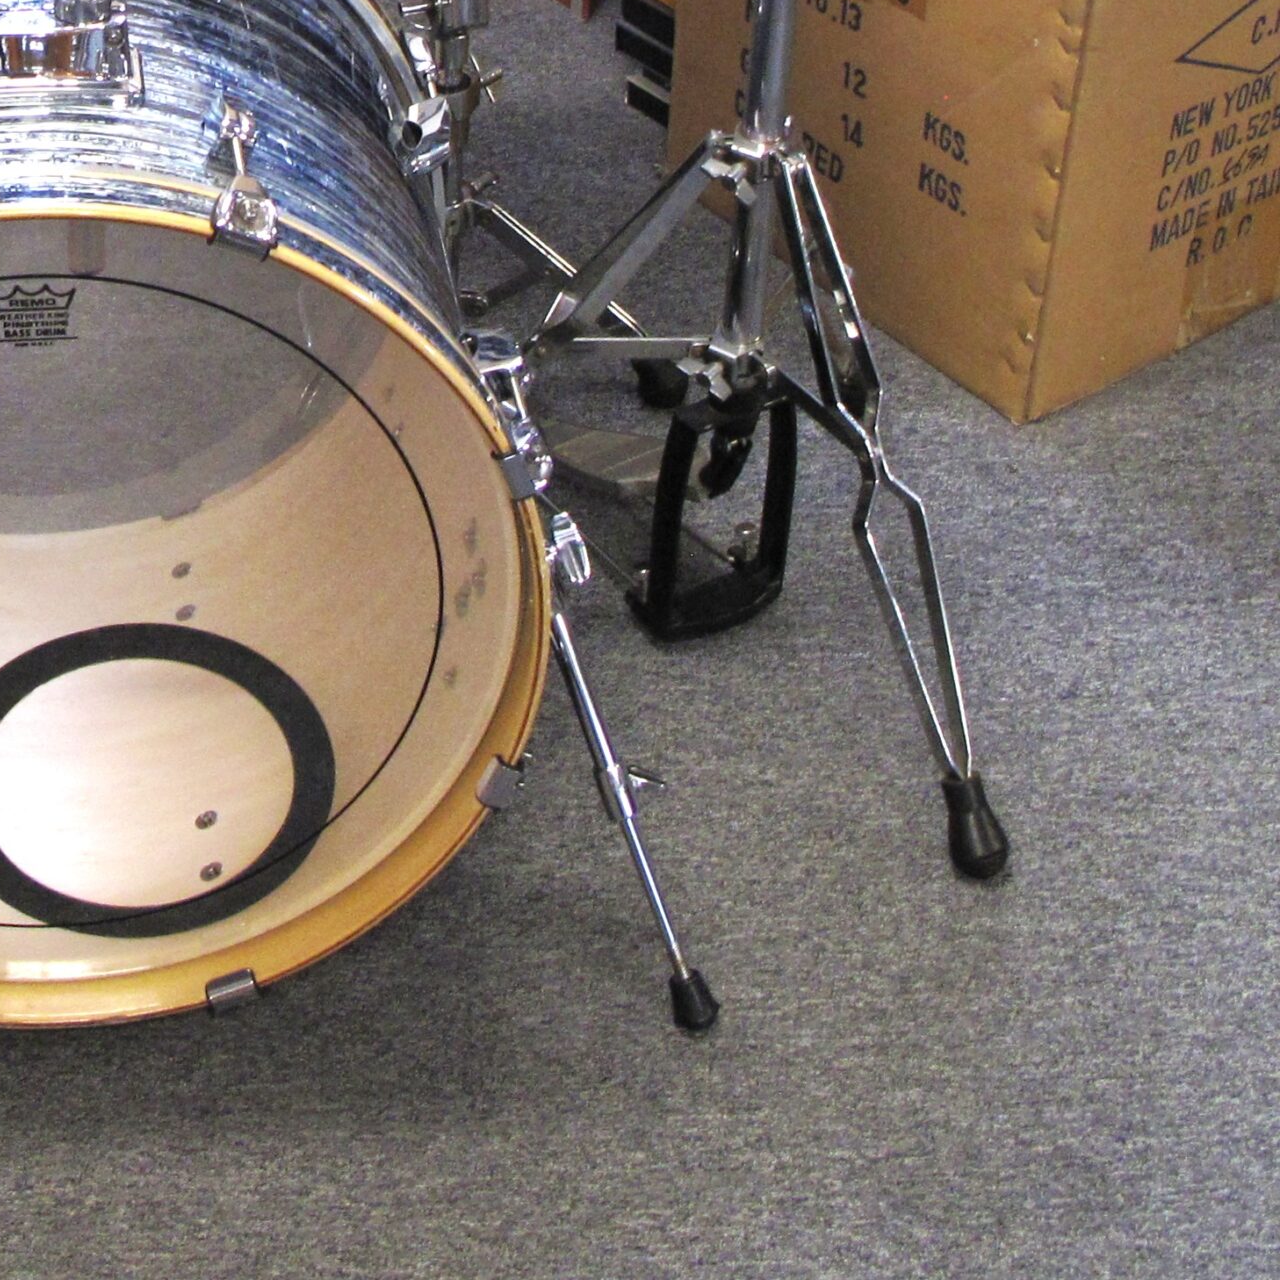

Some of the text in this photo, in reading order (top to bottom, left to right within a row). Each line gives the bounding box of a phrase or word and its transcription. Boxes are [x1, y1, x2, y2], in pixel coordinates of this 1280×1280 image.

[842, 61, 867, 100] 12
[1170, 71, 1278, 142] NEW YORK
[839, 111, 970, 166] 14 KGS.
[918, 162, 968, 218] KGS.
[1150, 197, 1212, 252] MADE
[1216, 186, 1238, 220] IN
[8, 298, 57, 308] REMO
